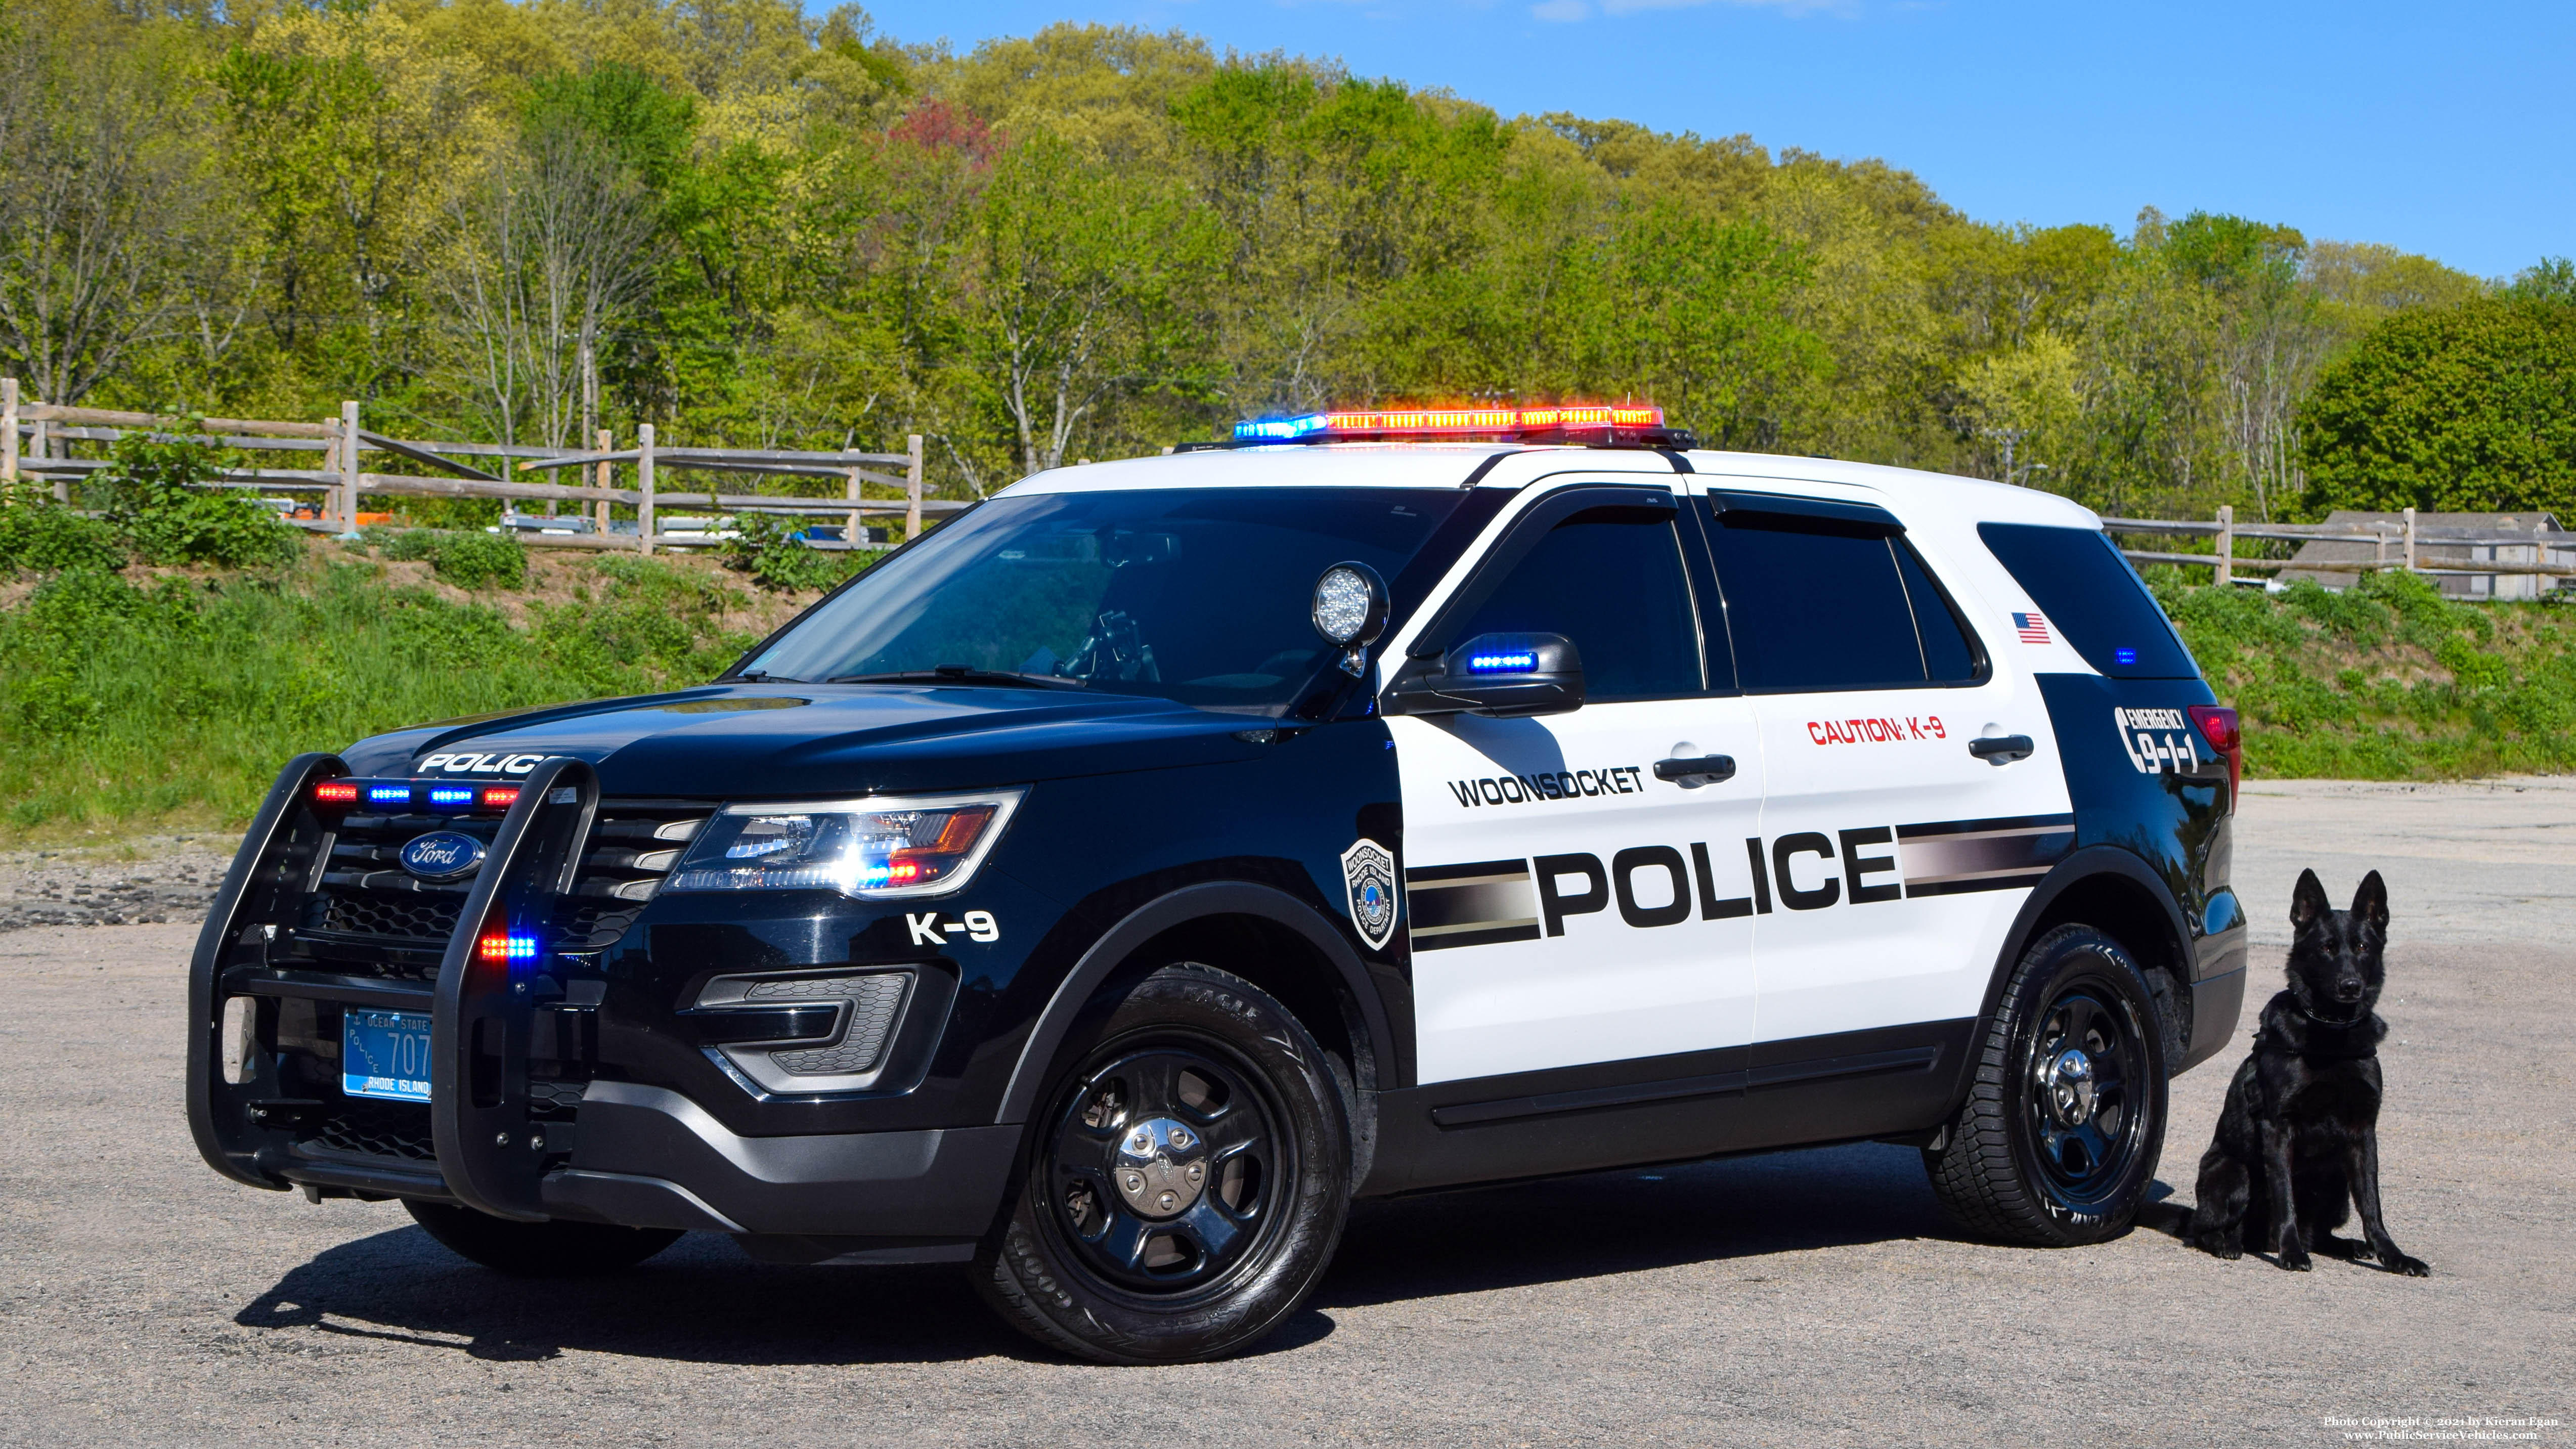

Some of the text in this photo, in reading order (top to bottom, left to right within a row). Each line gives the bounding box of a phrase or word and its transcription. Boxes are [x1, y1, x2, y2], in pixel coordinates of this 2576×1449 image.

[1807, 716, 1946, 745] CAUTION: K-9
[2125, 709, 2185, 729] EMERGENCY
[417, 754, 575, 773] POLIC
[2137, 733, 2198, 773] 9-1-1
[1448, 767, 1645, 808] WOONSOCKET
[412, 842, 461, 864] Ford
[1347, 847, 1389, 871] WOONSOCKET
[1351, 866, 1390, 889] RHODE ISLAND
[1533, 826, 1901, 938] POLICE
[906, 911, 999, 945] K-9
[1356, 898, 1390, 935] POLICE DEPARTMENT
[368, 1016, 427, 1031] OCEAN STATE
[350, 1029, 378, 1073] POLICE
[388, 1032, 430, 1076] 707
[369, 1076, 429, 1094] RHODE ISLAND
